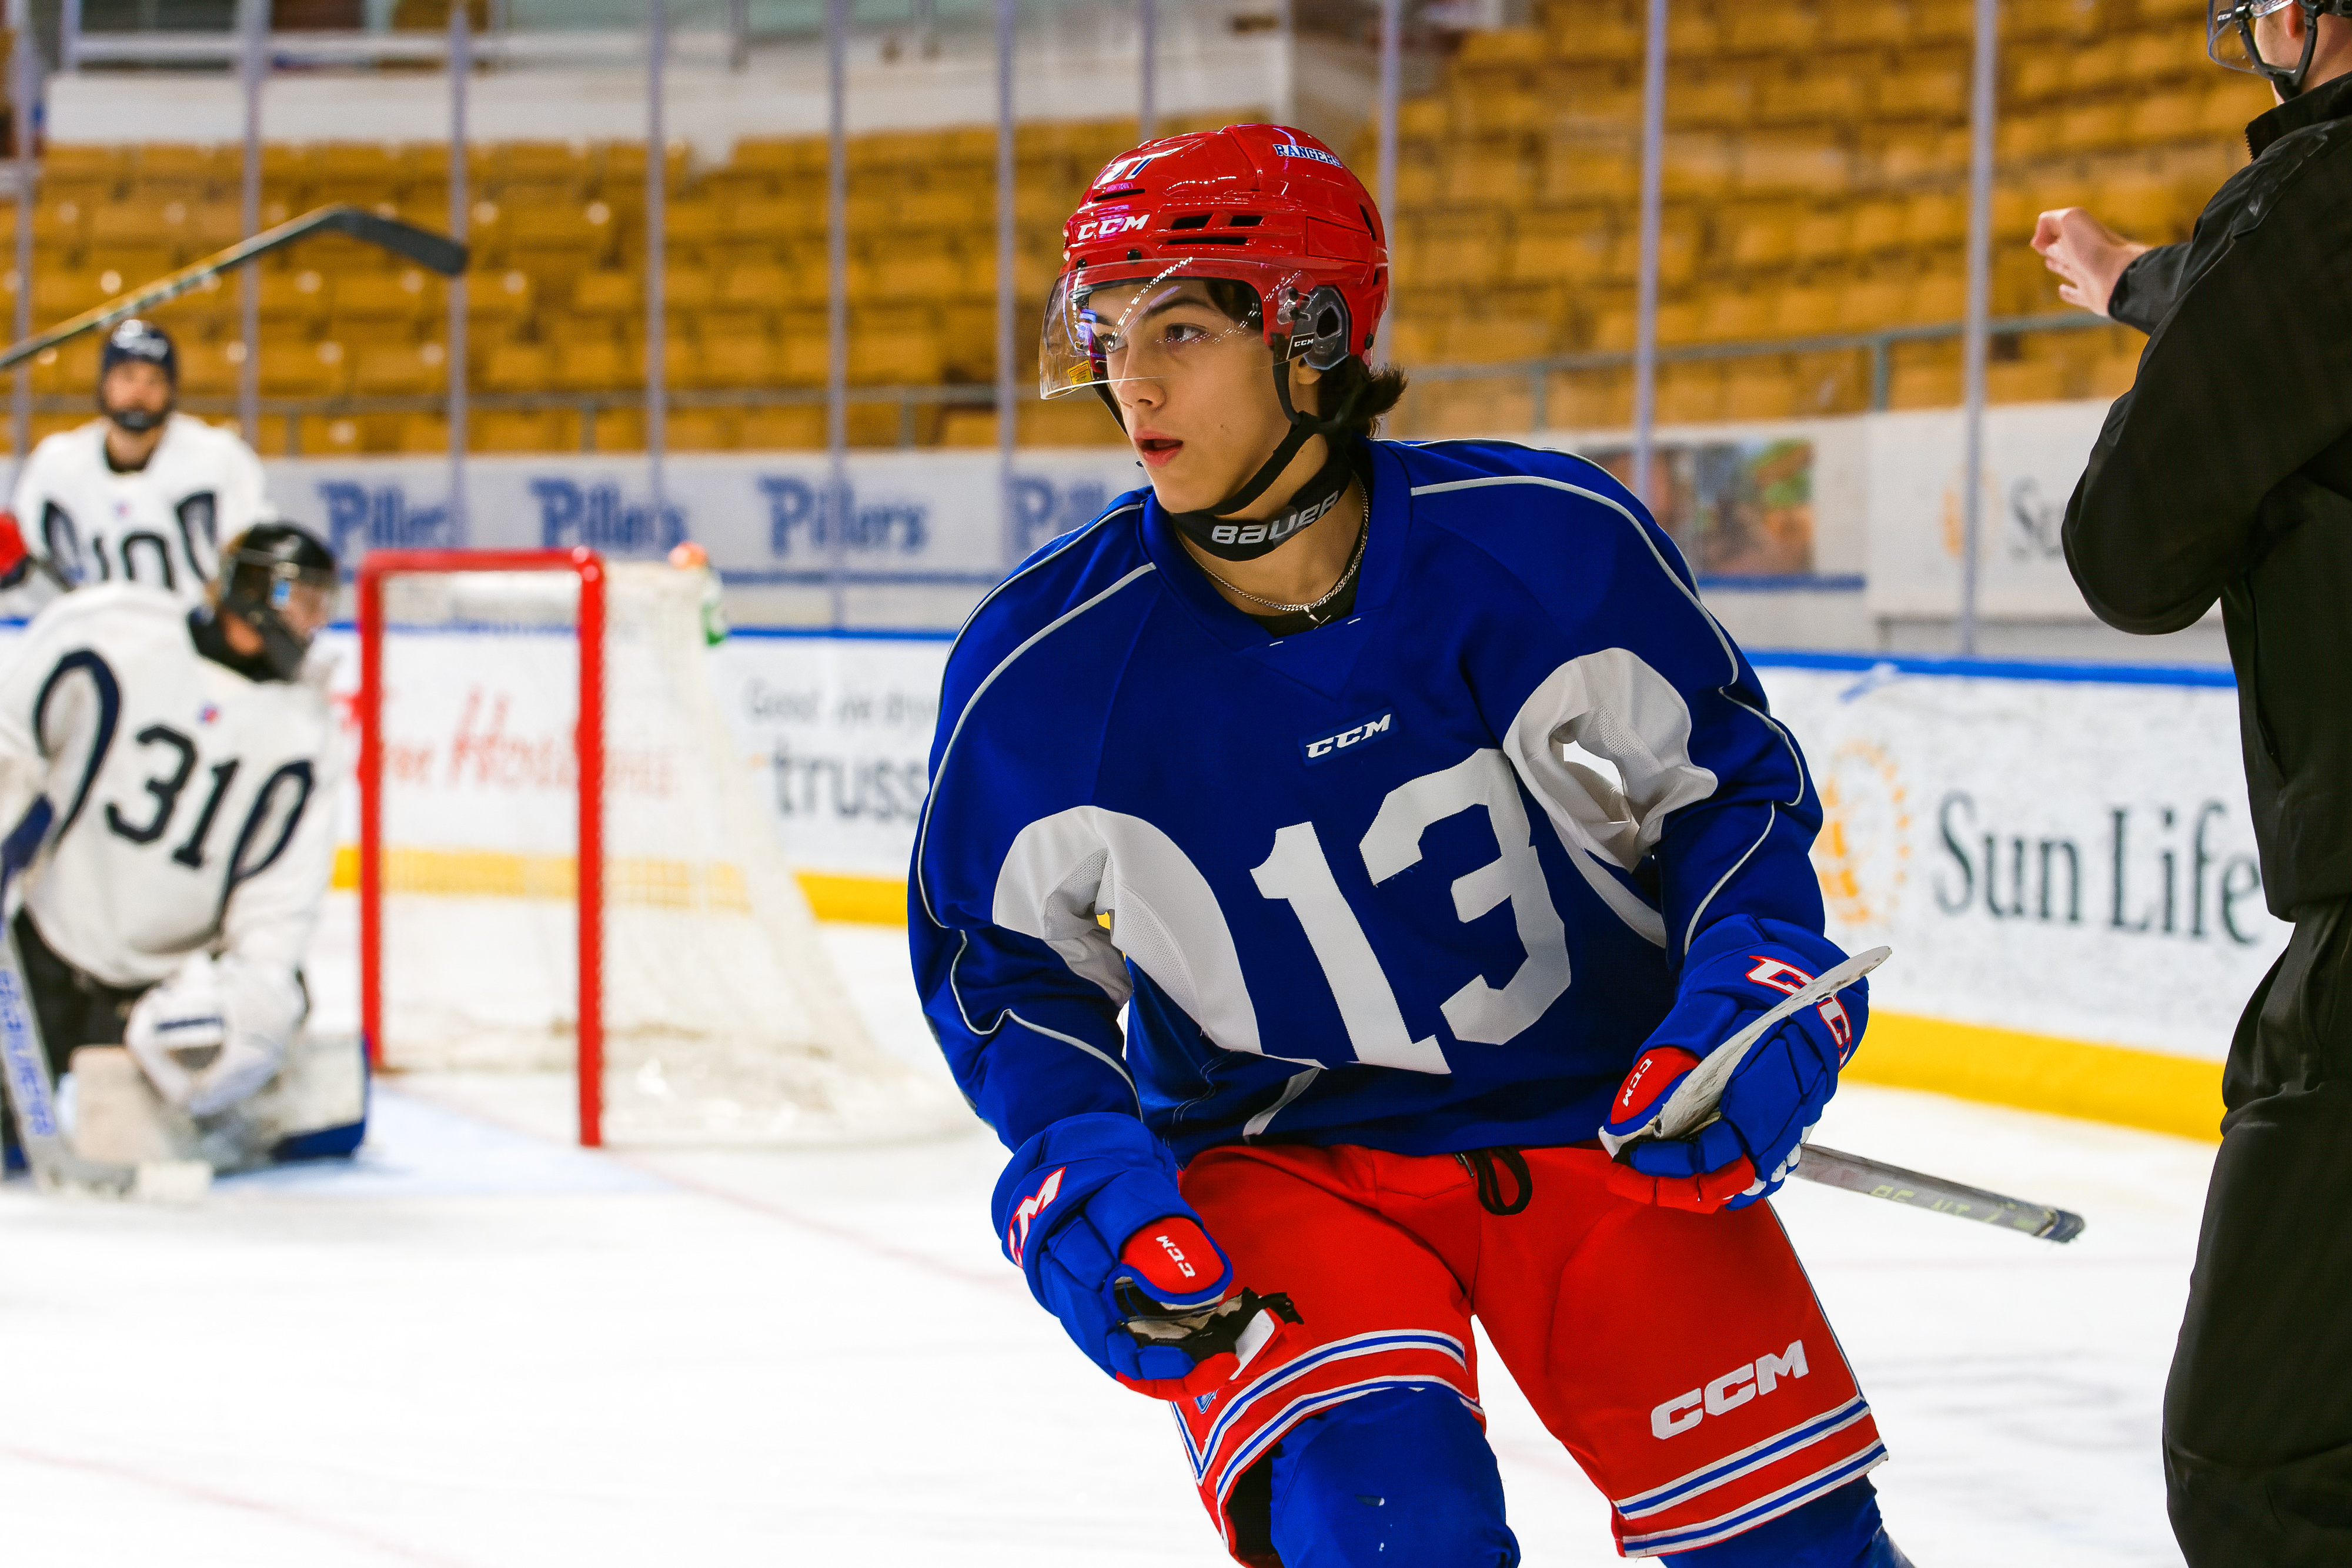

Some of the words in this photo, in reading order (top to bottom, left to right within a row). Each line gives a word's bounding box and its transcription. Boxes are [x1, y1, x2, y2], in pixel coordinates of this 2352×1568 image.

[1272, 143, 1343, 169] RANGERS
[1077, 213, 1151, 242] CCM
[1294, 338, 1314, 348] CCM
[1305, 713, 1392, 758] CCM
[103, 726, 238, 868] 31
[1934, 789, 2082, 924] Sun
[2110, 800, 2261, 945] Life
[1249, 747, 1571, 1075] 13
[1622, 1058, 1653, 1107] CCM
[1155, 1235, 1196, 1278] CCM
[1651, 1339, 1809, 1440] CCM
